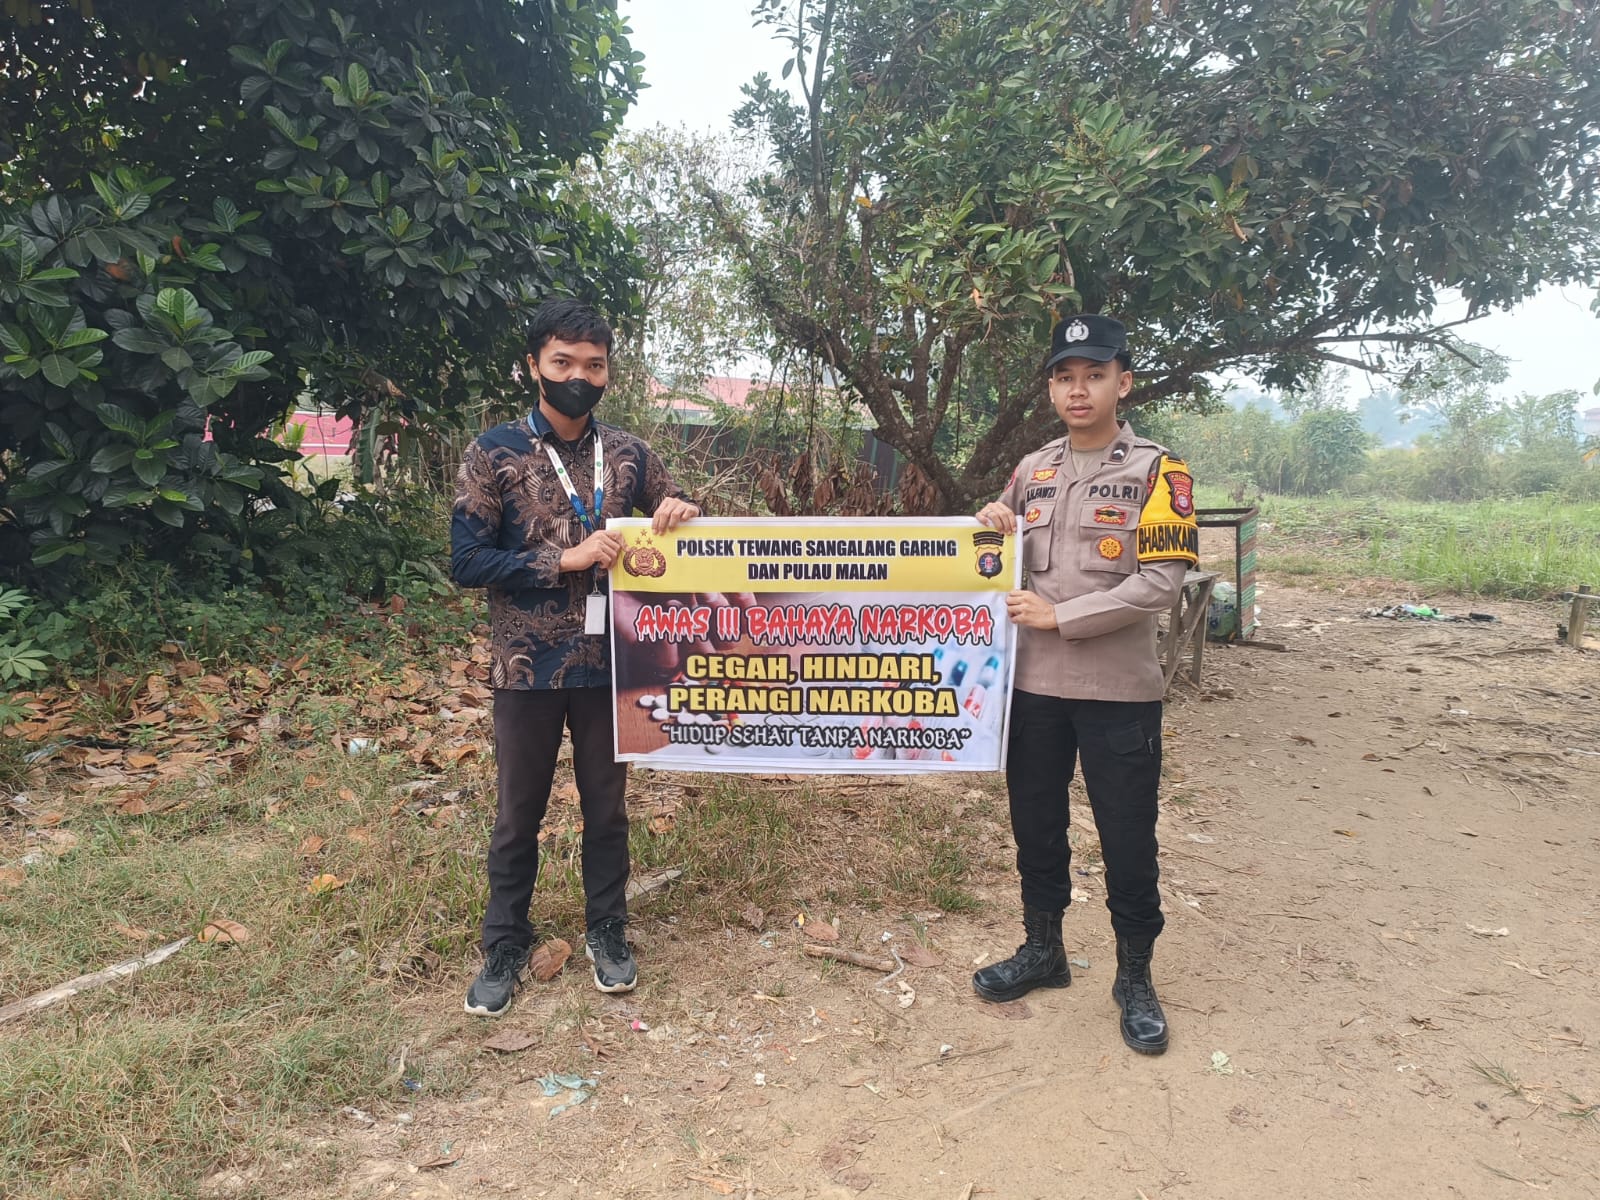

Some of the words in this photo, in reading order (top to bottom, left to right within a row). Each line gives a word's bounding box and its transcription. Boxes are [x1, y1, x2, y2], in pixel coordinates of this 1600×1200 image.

[1089, 484, 1138, 499] POLRI
[677, 540, 734, 556] POLSEK
[737, 540, 802, 556] TEWANG
[806, 540, 896, 556] SANGALANG
[900, 540, 957, 556] GARING
[748, 563, 779, 580] DAN
[783, 563, 831, 580] PULAU
[836, 563, 888, 580] MALAN
[636, 605, 711, 643] AWAS
[746, 604, 856, 646] BAHAYA
[861, 605, 994, 645] NARKOBA
[686, 655, 796, 682] CEGAH,
[803, 656, 939, 683] HINDARI,
[670, 687, 801, 712] PERANGI
[809, 688, 957, 714] NARKOBA
[731, 725, 794, 745] SEHAT
[800, 726, 865, 747] TANPA
